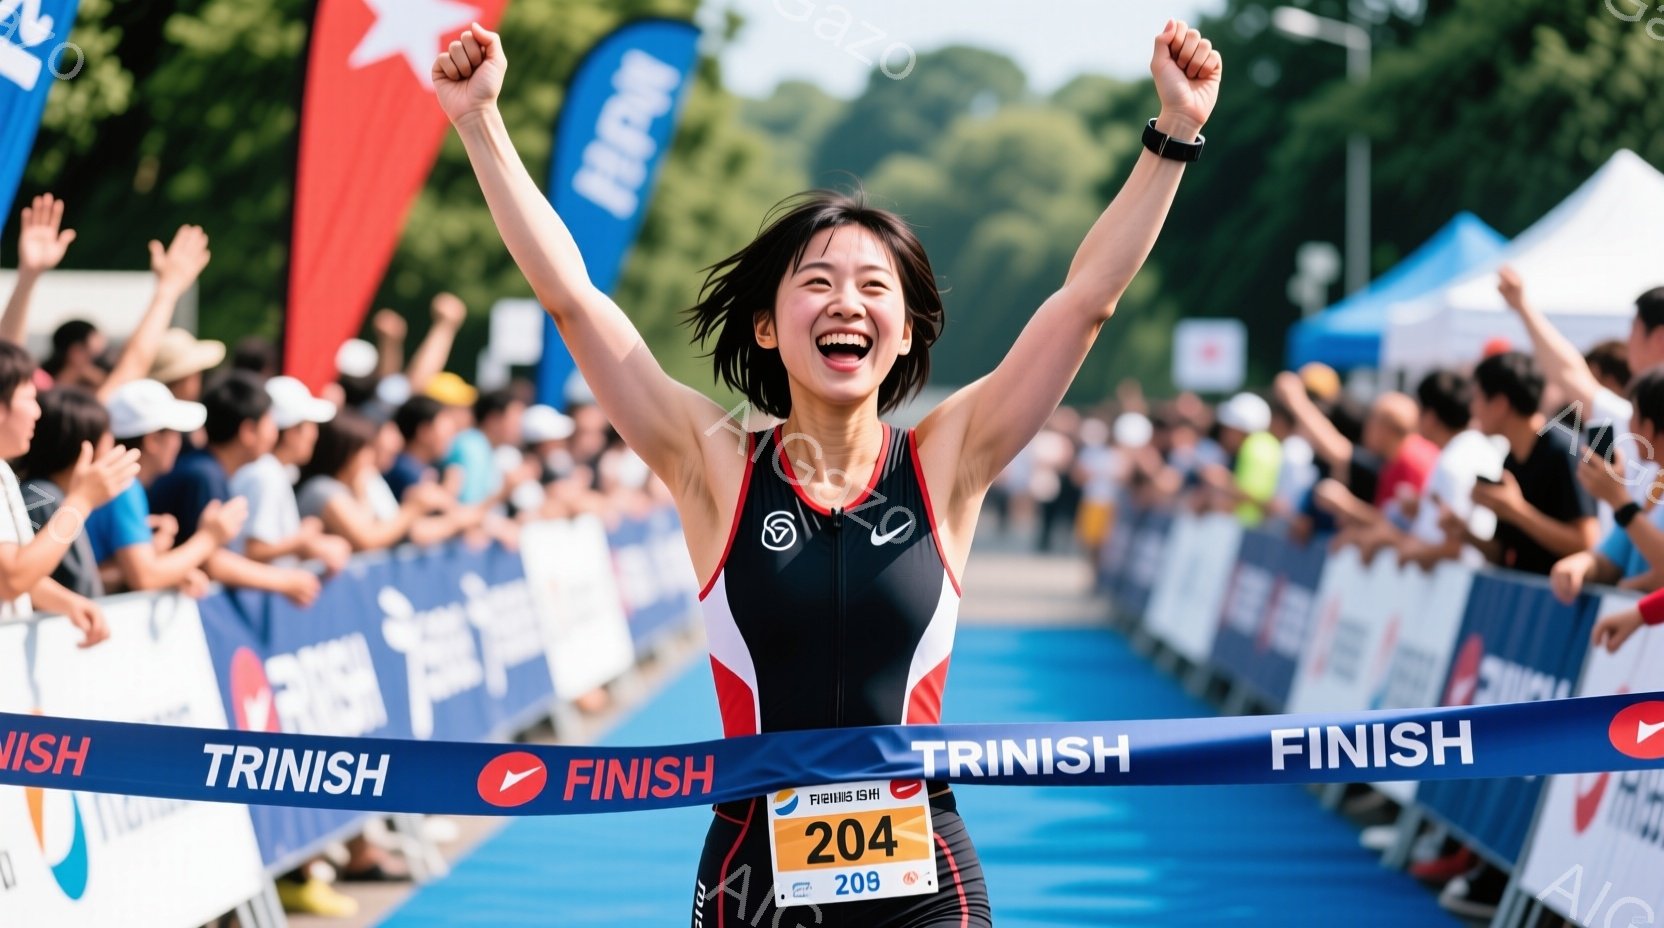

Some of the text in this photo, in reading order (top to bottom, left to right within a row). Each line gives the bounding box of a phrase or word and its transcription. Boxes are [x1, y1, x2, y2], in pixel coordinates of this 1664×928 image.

[203, 743, 391, 797] TRINISH
[563, 755, 715, 800] FINISH
[910, 734, 1131, 778] TRINISH
[1270, 719, 1475, 771] FINISH
[804, 815, 899, 865] 204
